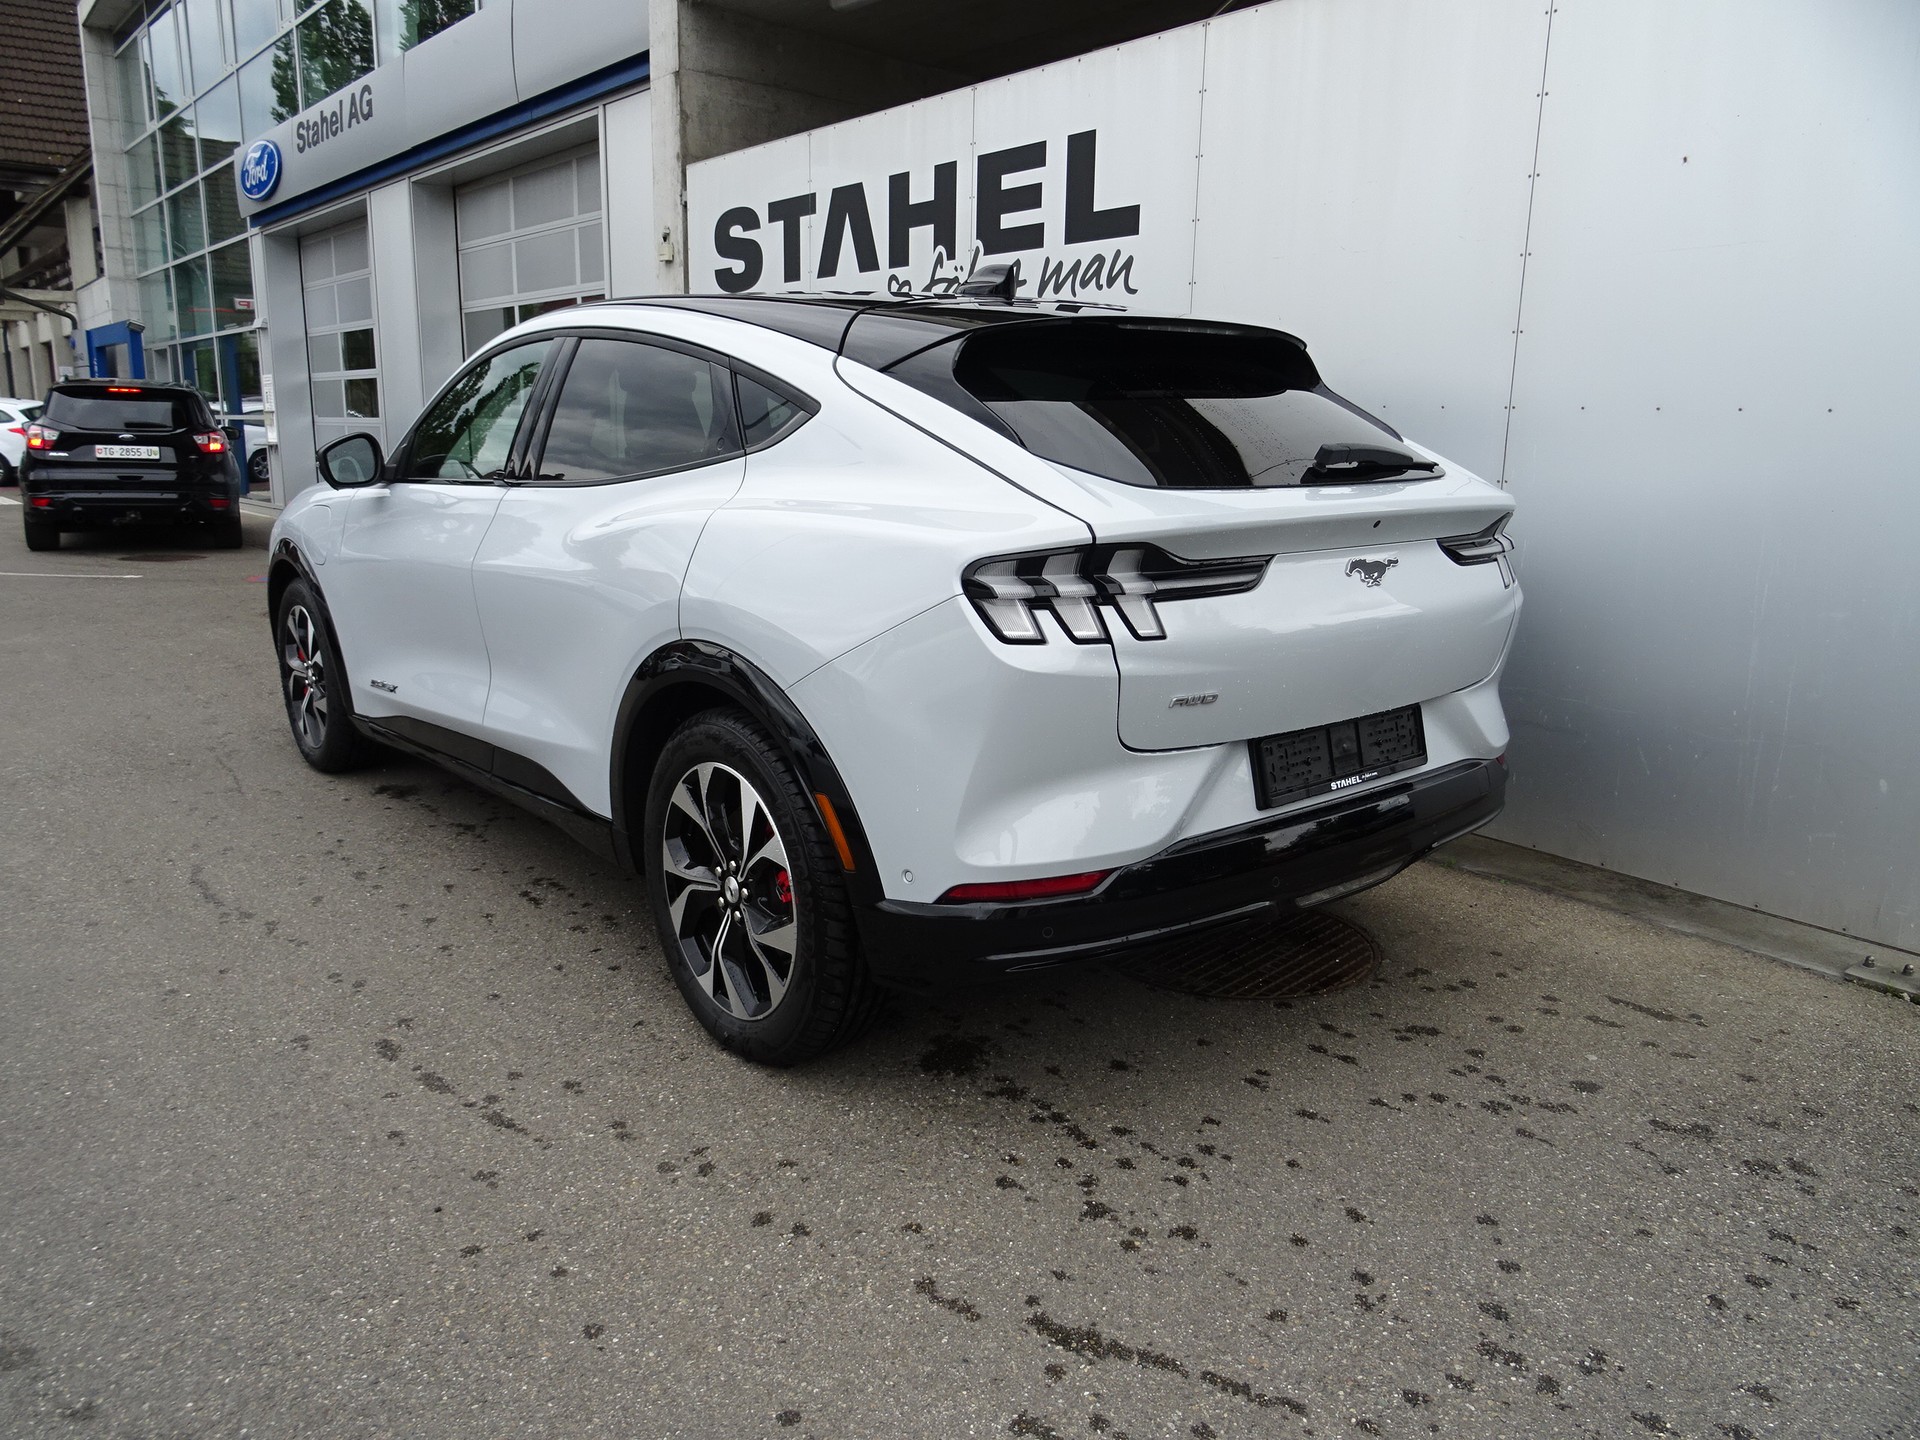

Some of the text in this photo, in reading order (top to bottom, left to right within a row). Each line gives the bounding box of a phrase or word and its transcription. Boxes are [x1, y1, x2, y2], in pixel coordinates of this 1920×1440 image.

[296, 84, 374, 154] Stahel AG
[713, 128, 1141, 294] STAHEL
[1037, 248, 1139, 298] man
[1168, 692, 1219, 708] AWD
[1330, 775, 1363, 790] STAHEL
